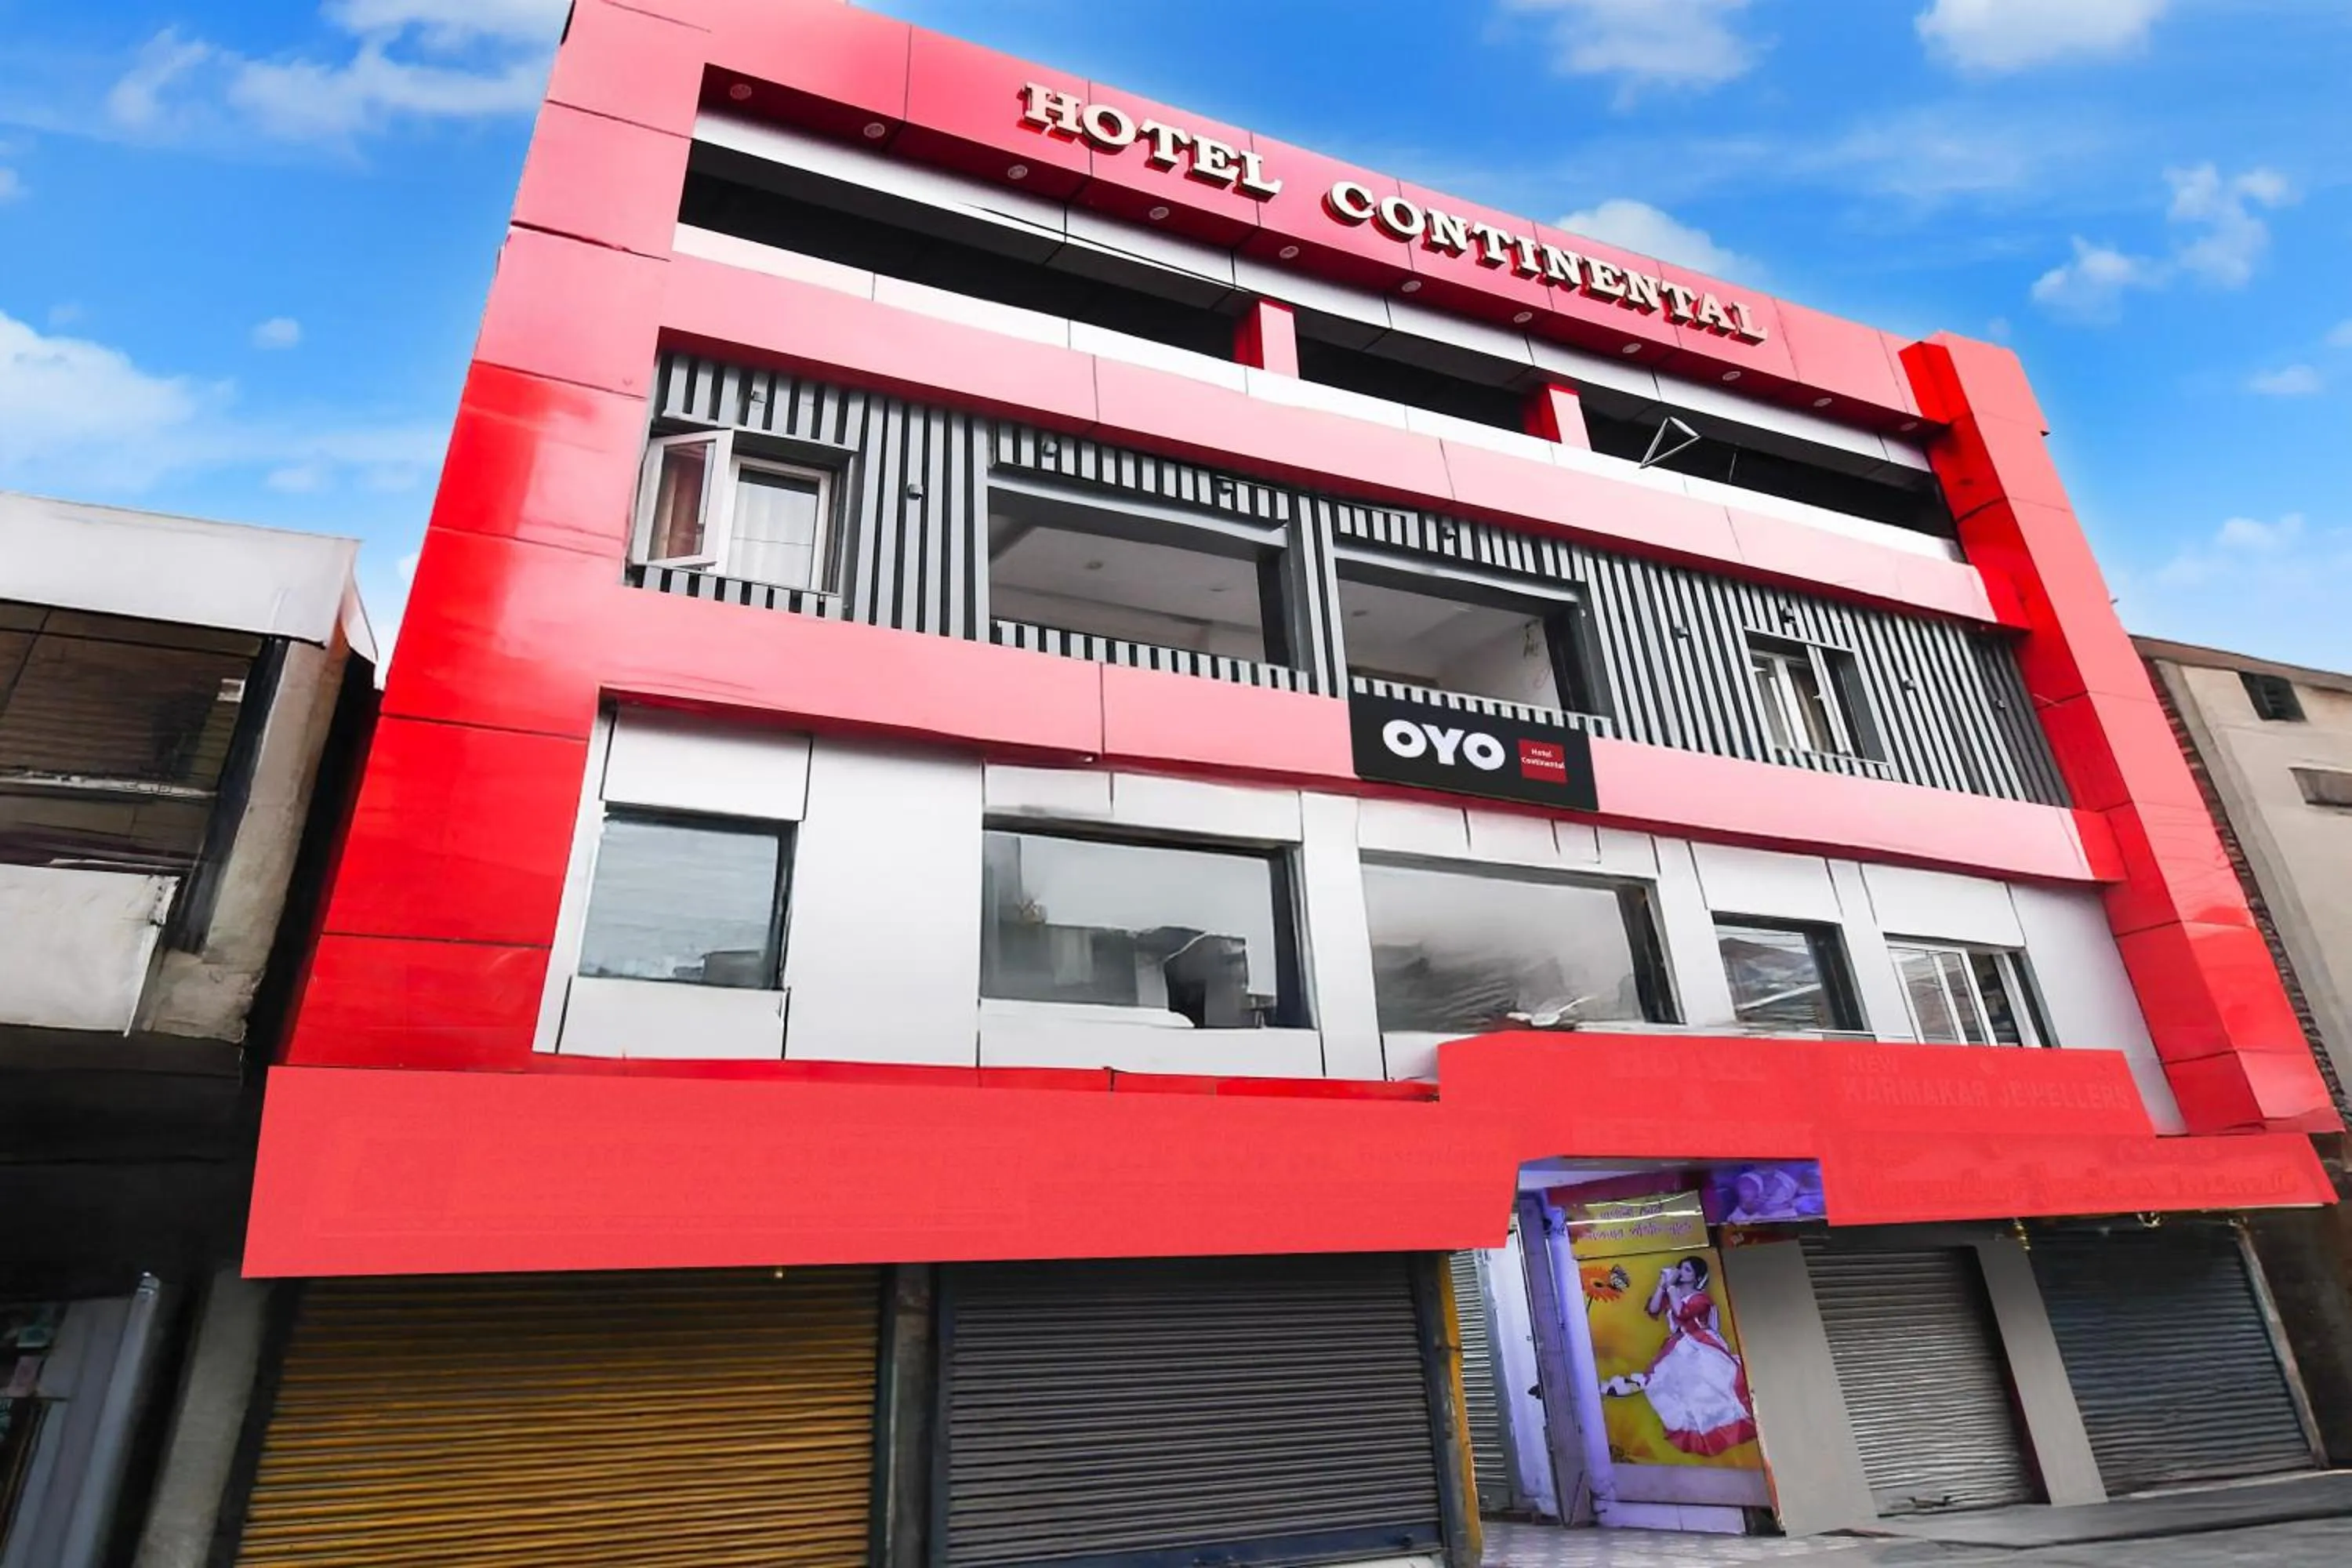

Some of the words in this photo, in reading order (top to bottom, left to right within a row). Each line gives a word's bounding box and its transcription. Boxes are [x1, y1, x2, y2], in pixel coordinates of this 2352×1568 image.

[1021, 82, 1283, 197] HOTEL
[1327, 180, 1768, 343] CONTINENTAL
[1382, 719, 1506, 771] OYO
[1530, 748, 1552, 758] Hotel
[1521, 757, 1566, 769] Continental
